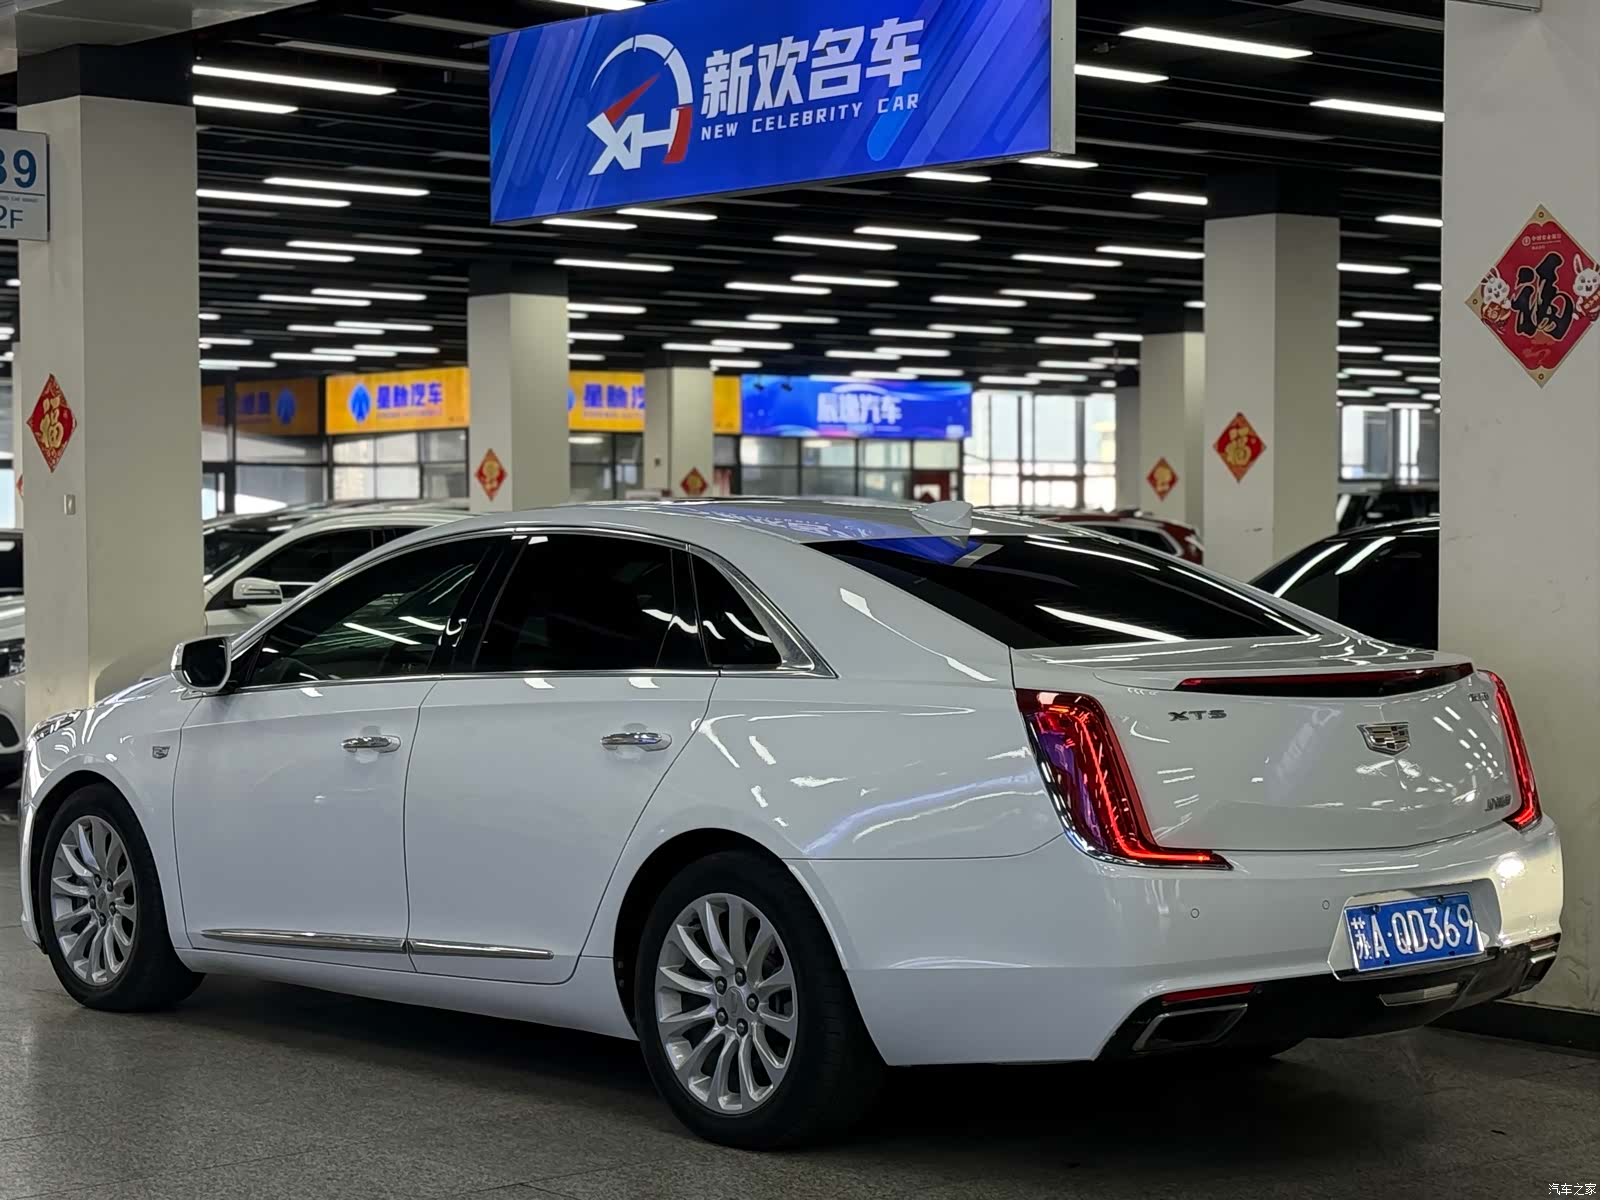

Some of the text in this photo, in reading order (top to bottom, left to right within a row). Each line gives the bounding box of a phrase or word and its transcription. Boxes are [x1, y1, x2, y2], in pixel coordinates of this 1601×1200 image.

[701, 17, 925, 119] 新欢名车
[701, 93, 919, 141] NEW CELEBRITY CAR
[1511, 251, 1576, 341] 福
[40, 395, 65, 449] 福
[1225, 427, 1252, 466] 福
